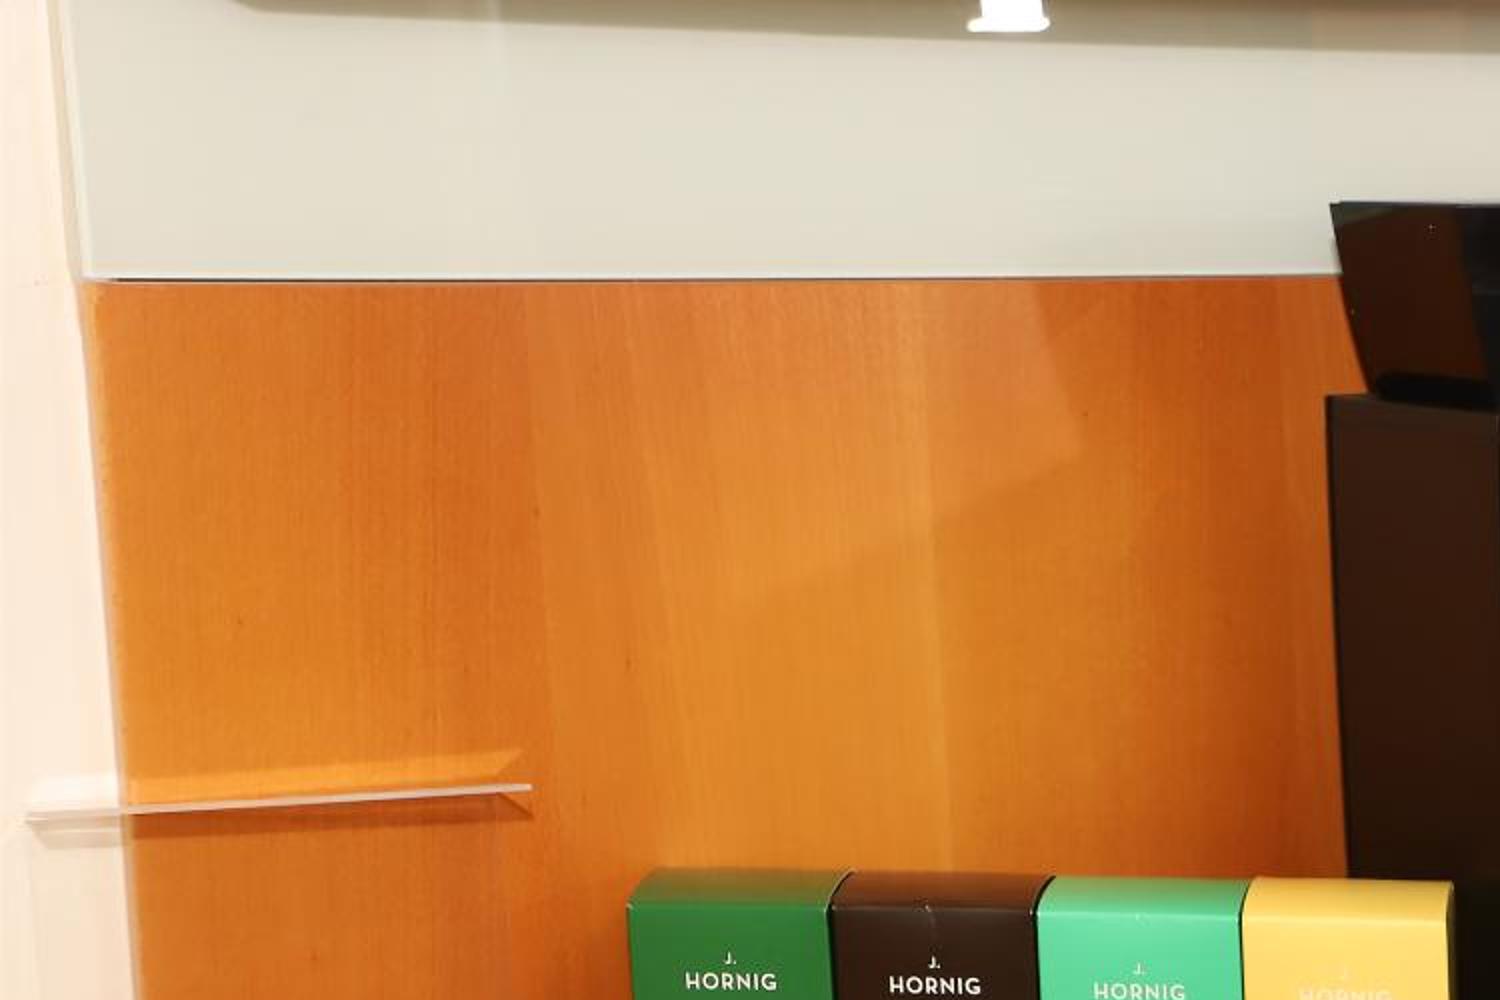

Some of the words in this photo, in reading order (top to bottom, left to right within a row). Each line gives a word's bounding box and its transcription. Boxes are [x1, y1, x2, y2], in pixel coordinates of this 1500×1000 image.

[685, 973, 777, 991] HORNIG
[889, 977, 981, 995] HORNIG
[1094, 983, 1186, 1000] HORNIG
